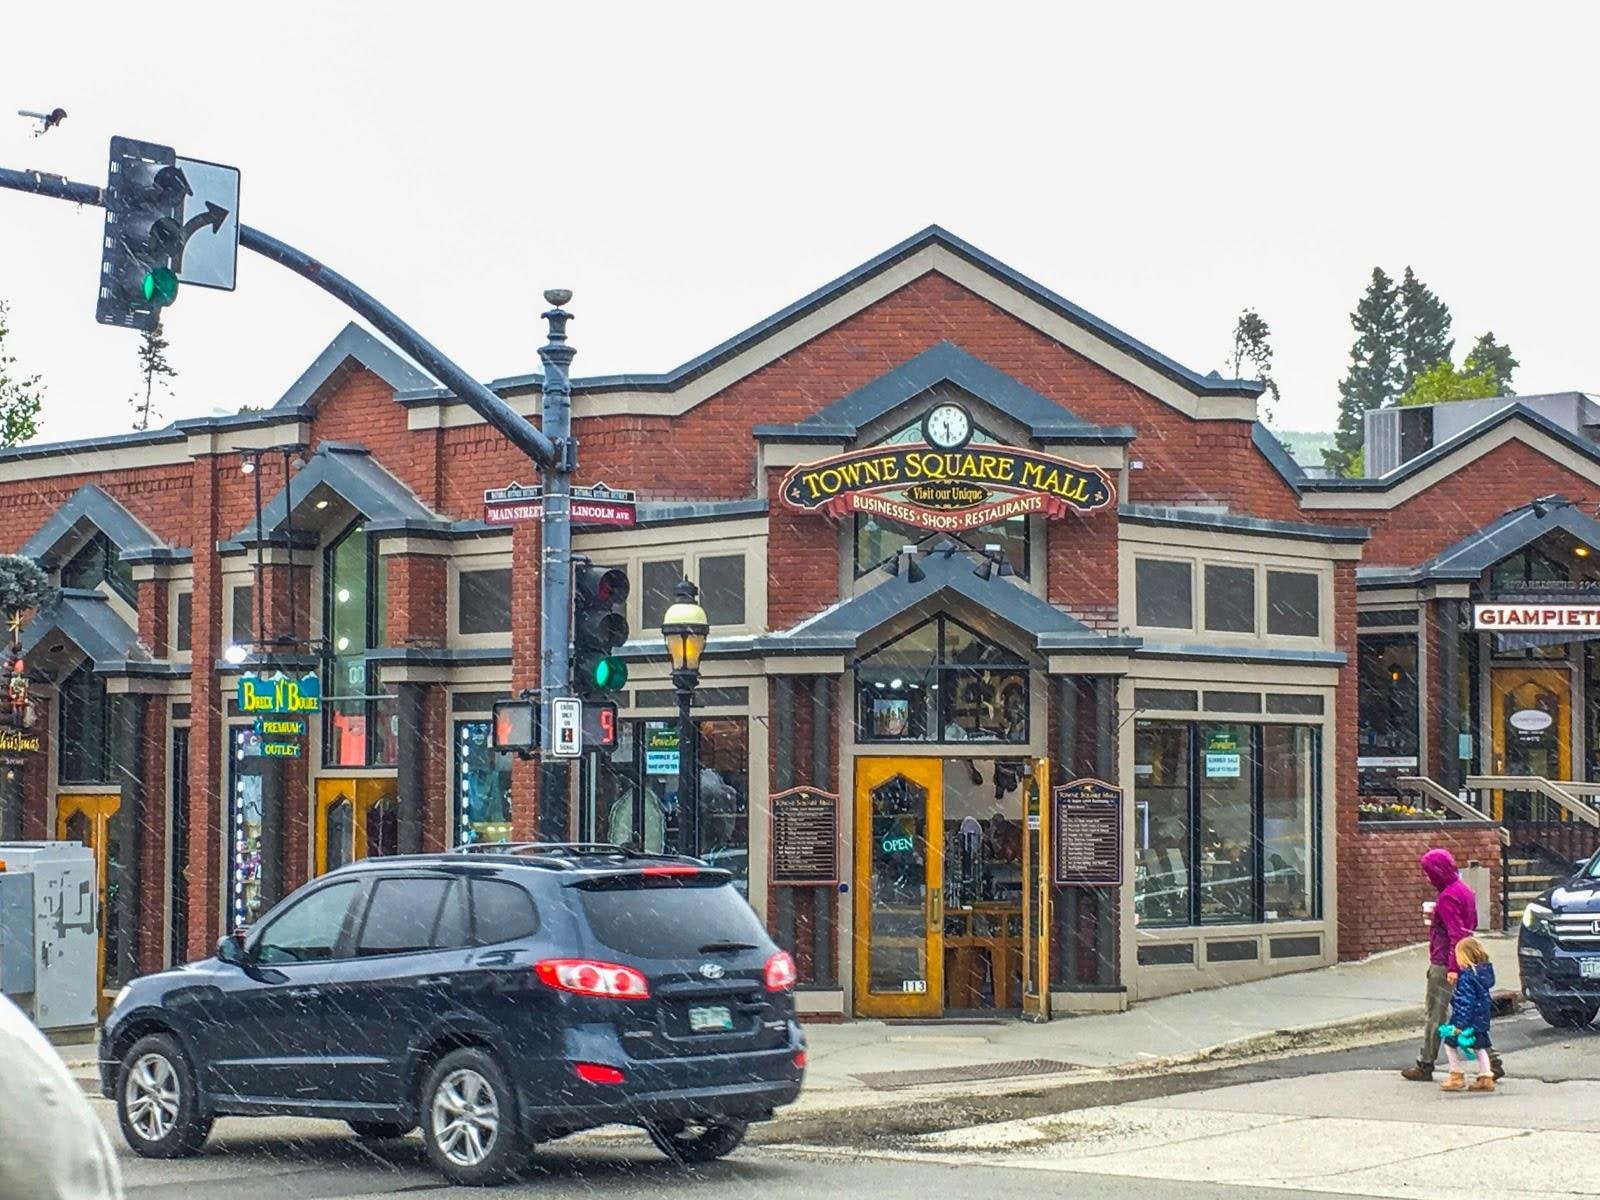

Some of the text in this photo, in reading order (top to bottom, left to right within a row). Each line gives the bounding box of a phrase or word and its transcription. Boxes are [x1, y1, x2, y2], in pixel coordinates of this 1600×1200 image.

[802, 453, 1091, 502] TOWNE SQUARE MALL
[913, 487, 983, 503] Visit our Unique
[492, 508, 514, 521] MAIN
[514, 506, 544, 519] STREET
[572, 505, 630, 520] LINCOLN AVE
[853, 495, 1042, 529] BUSINESSES SHOPS RESTAURANTS
[263, 722, 299, 733] PREMIUM
[264, 744, 298, 756] OUTLET
[882, 836, 914, 852] OPEN
[905, 981, 926, 992] 113
